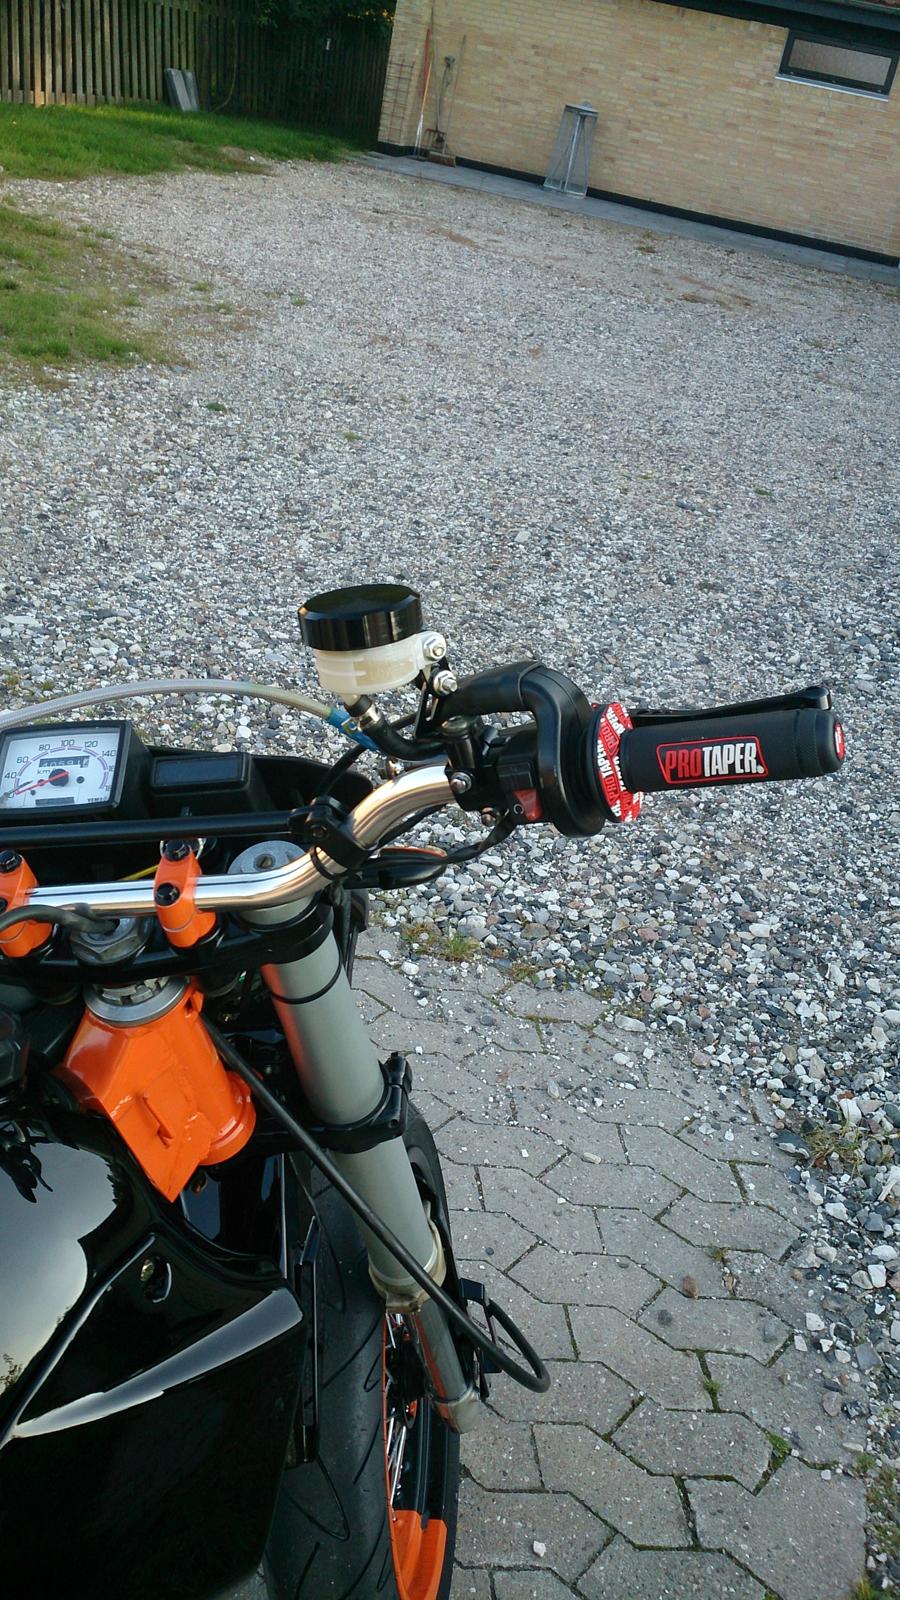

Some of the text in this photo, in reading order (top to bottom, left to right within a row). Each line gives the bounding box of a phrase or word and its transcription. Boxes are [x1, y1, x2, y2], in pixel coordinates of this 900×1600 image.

[61, 739, 75, 747] 100
[85, 740, 98, 748] 120
[102, 749, 116, 757] 140
[17, 756, 29, 764] 60
